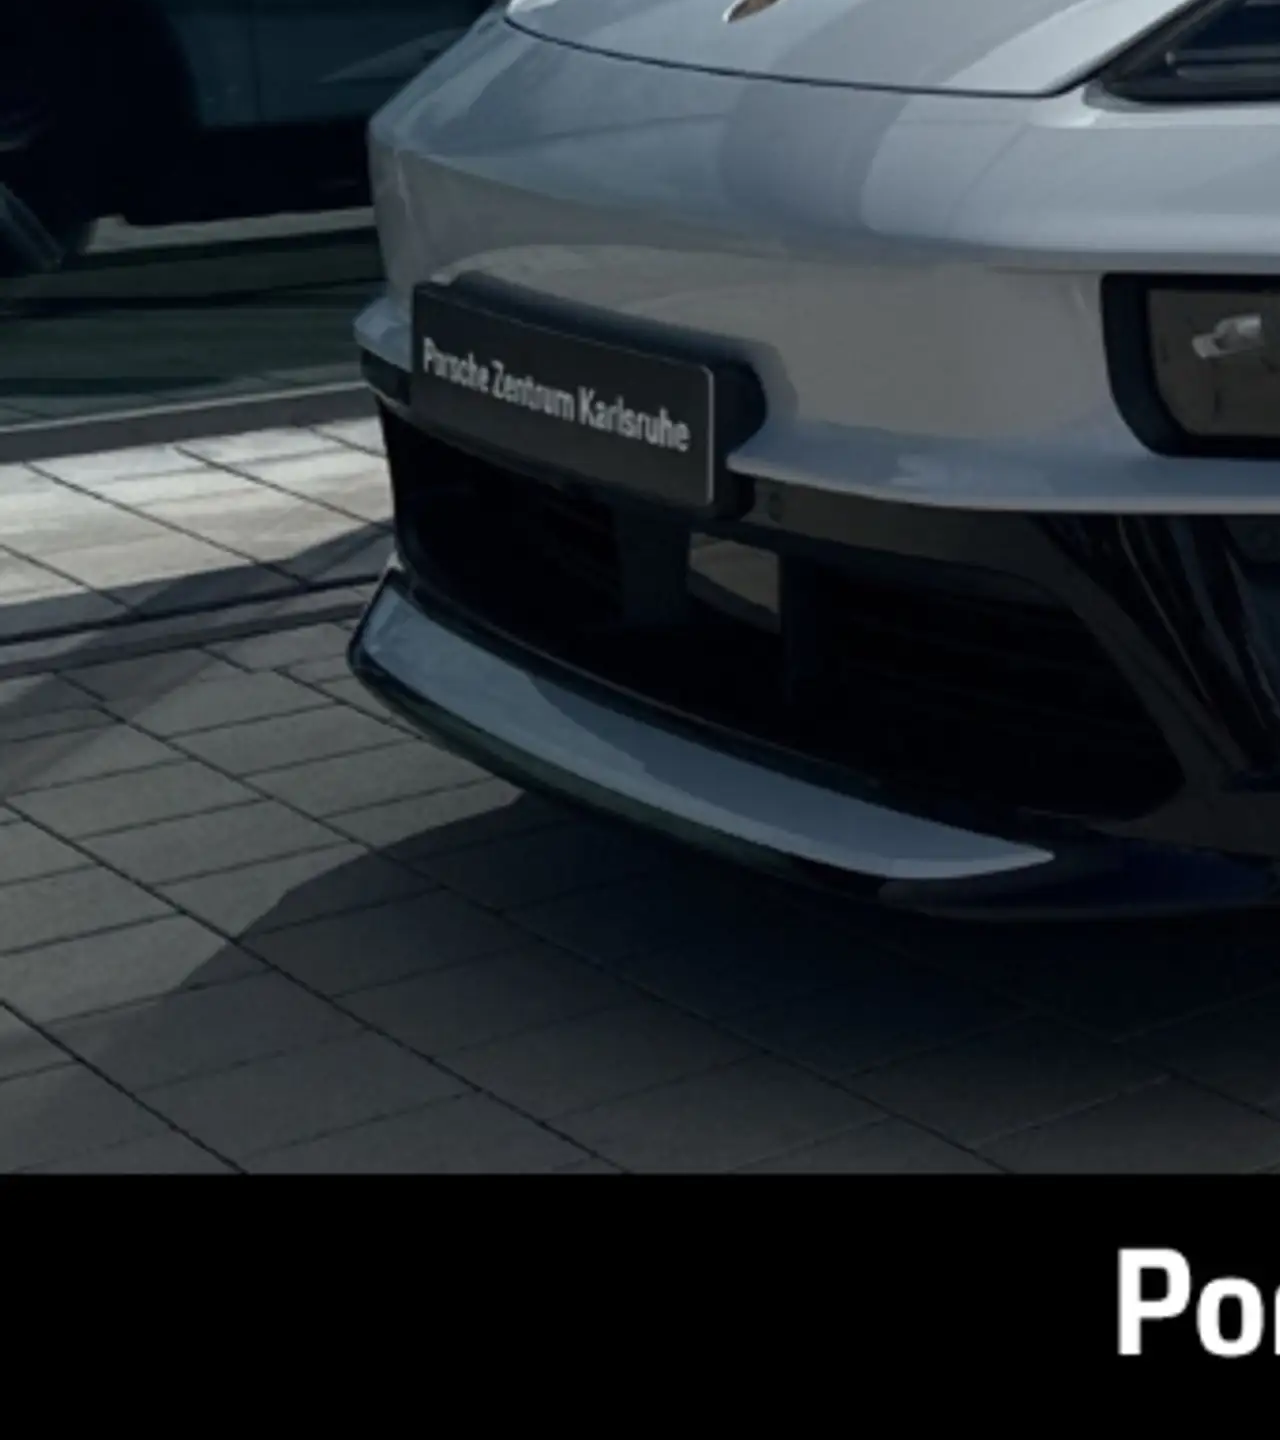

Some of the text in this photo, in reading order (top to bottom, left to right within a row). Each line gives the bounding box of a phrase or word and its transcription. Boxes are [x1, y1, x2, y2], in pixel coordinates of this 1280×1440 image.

[423, 336, 691, 452] Porsche Zentrum Karlsruhe
